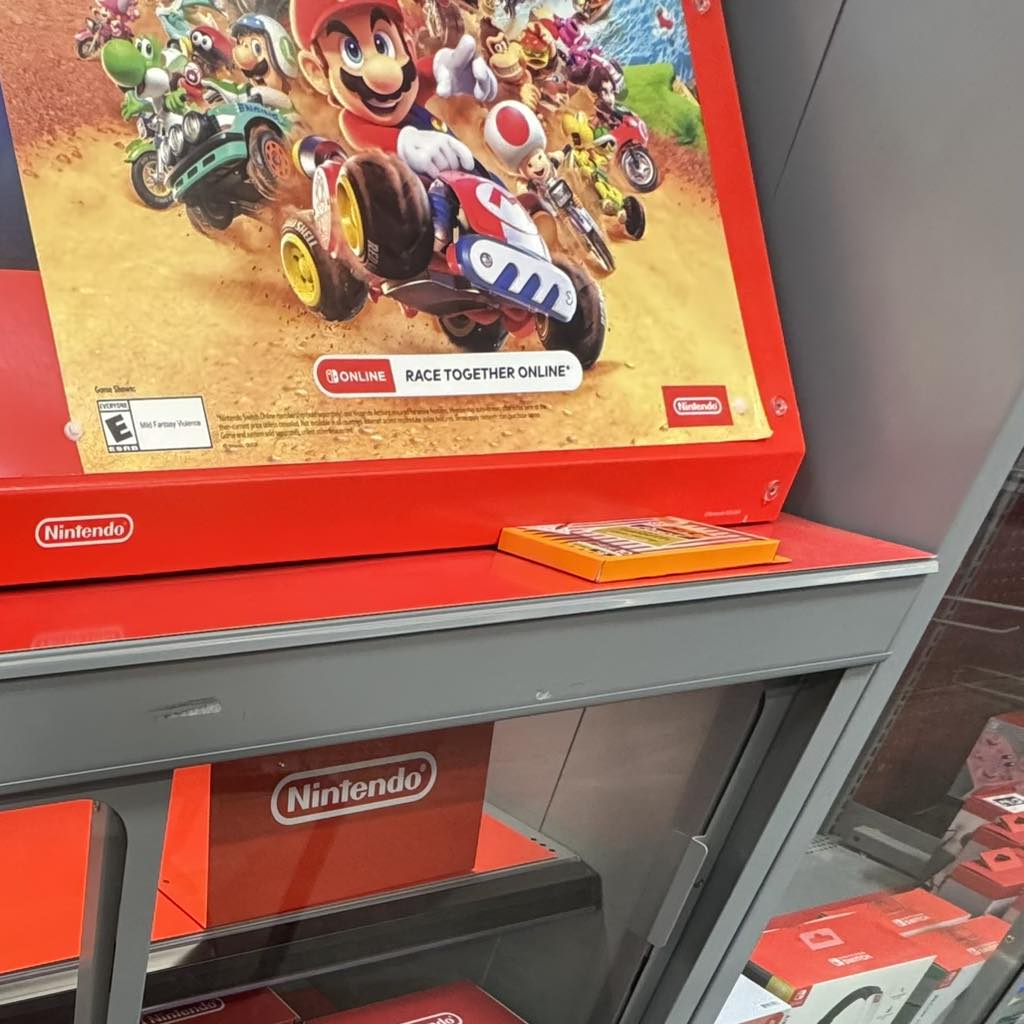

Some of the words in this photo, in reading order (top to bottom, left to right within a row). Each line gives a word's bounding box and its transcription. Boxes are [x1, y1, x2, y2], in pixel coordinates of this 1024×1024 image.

[339, 371, 387, 383] ONLINE
[405, 369, 441, 382] RACE
[445, 366, 514, 381] TOGETHER
[678, 401, 718, 412] Nintendo
[105, 414, 133, 443] E
[176, 419, 201, 427] Violence
